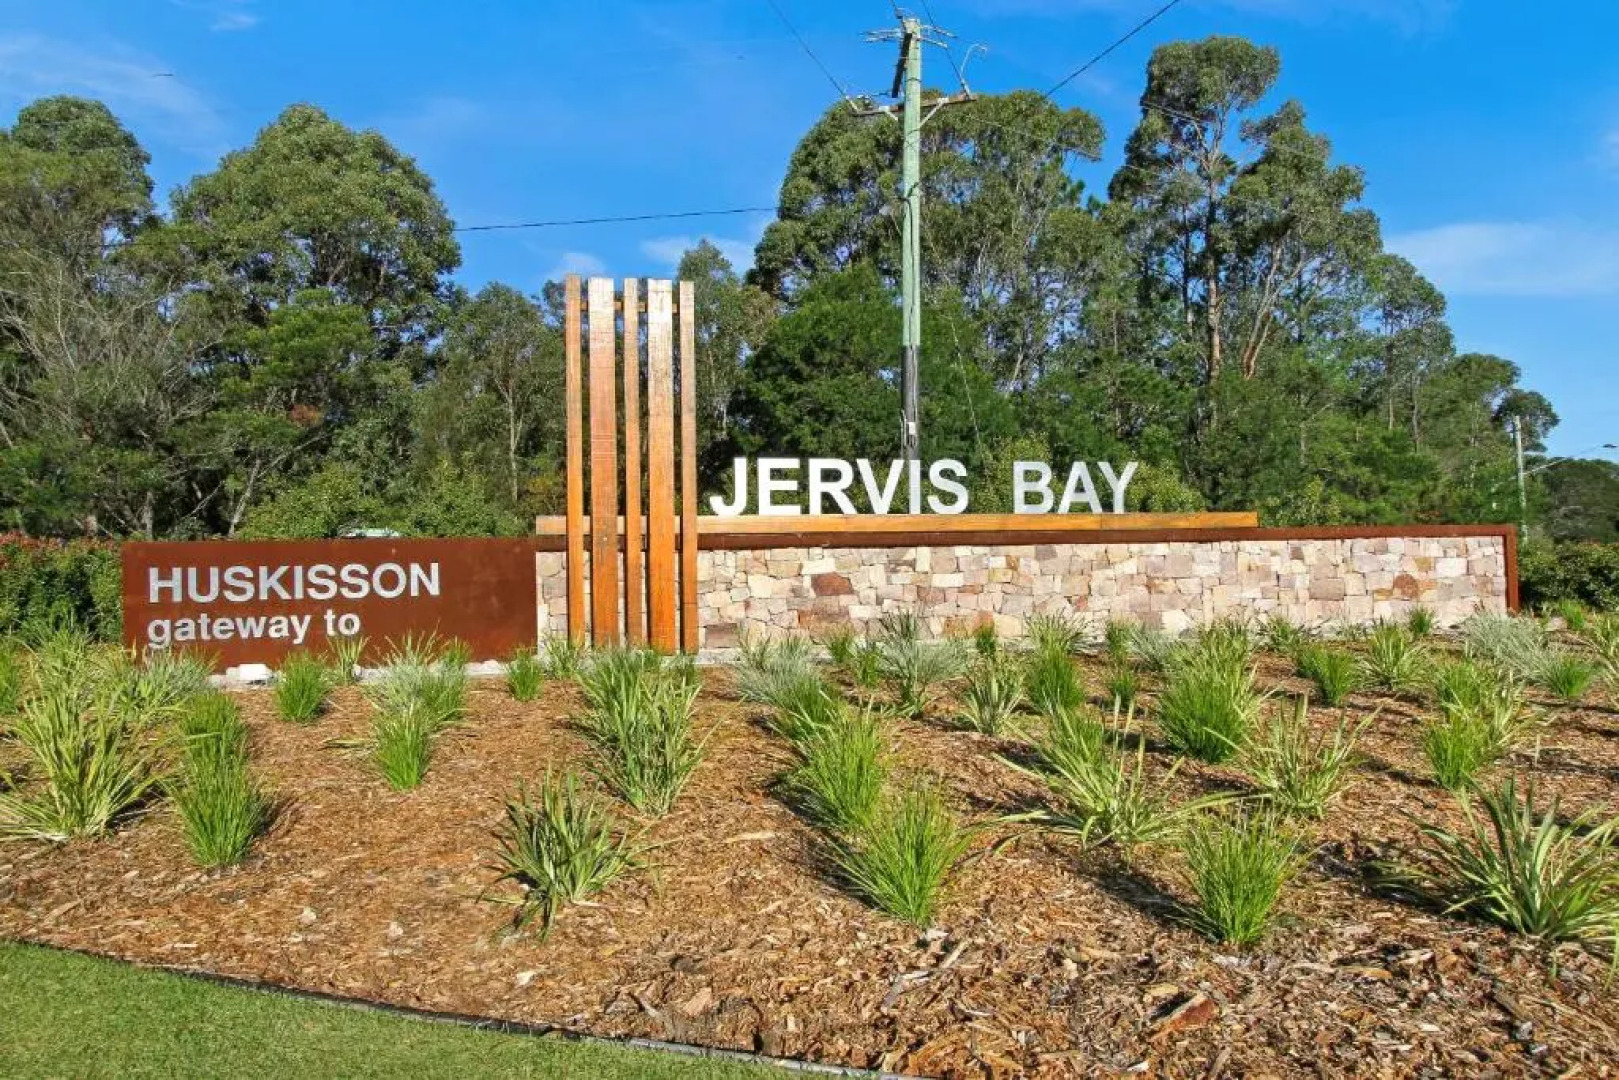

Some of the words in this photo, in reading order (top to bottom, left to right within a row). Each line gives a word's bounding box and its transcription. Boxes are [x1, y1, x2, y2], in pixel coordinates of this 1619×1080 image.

[709, 457, 969, 515] JERVIS
[1013, 461, 1139, 515] BAY
[148, 562, 441, 604] HUSKISSON
[147, 611, 312, 650] gateway
[324, 608, 361, 637] to
